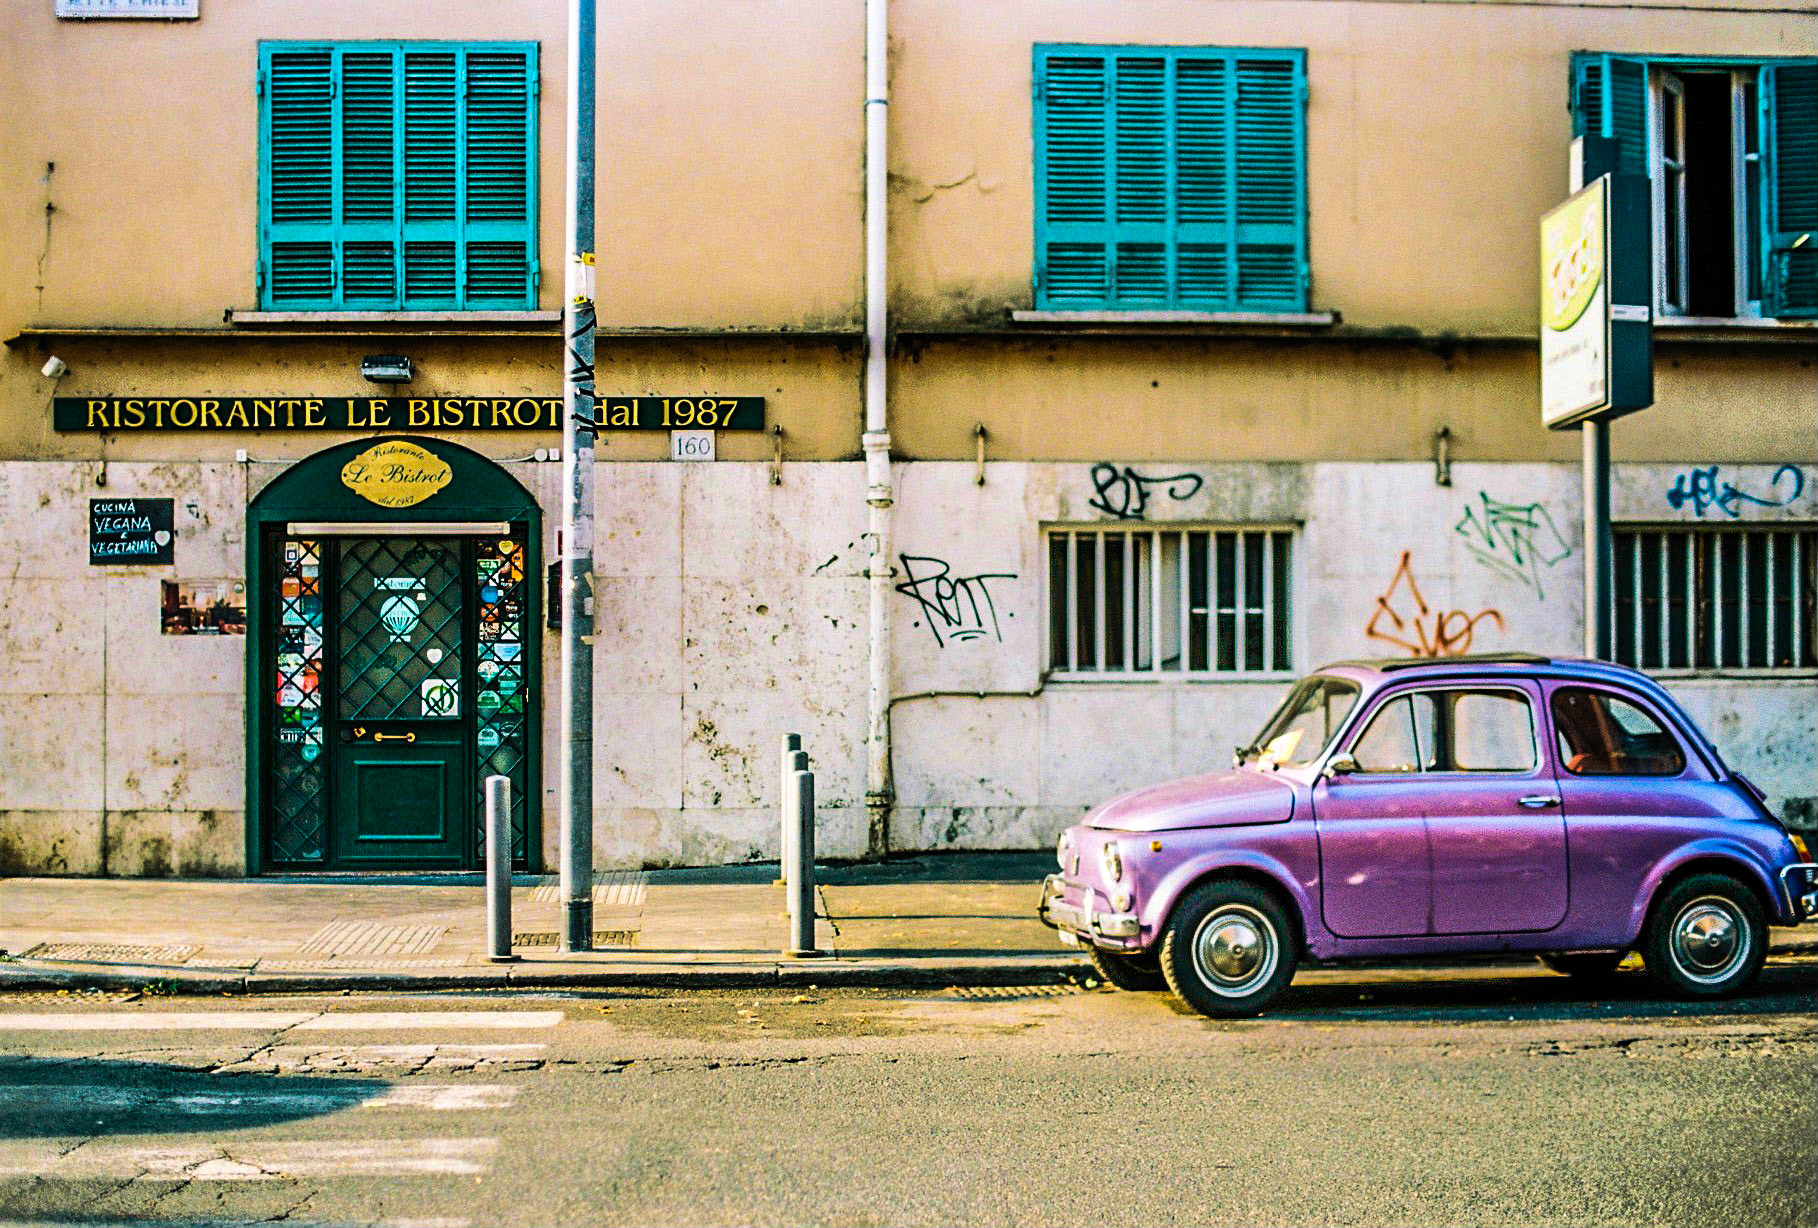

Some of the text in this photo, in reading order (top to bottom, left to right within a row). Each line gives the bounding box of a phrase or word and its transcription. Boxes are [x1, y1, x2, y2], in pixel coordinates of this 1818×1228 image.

[86, 398, 738, 428] RISTORANTE LE BISTROT dal 1987
[371, 445, 425, 461] Ristorante
[677, 436, 711, 456] 160
[346, 462, 447, 484] Le Bistrot
[93, 501, 136, 514] CUCINA
[94, 515, 152, 534] VEGANA
